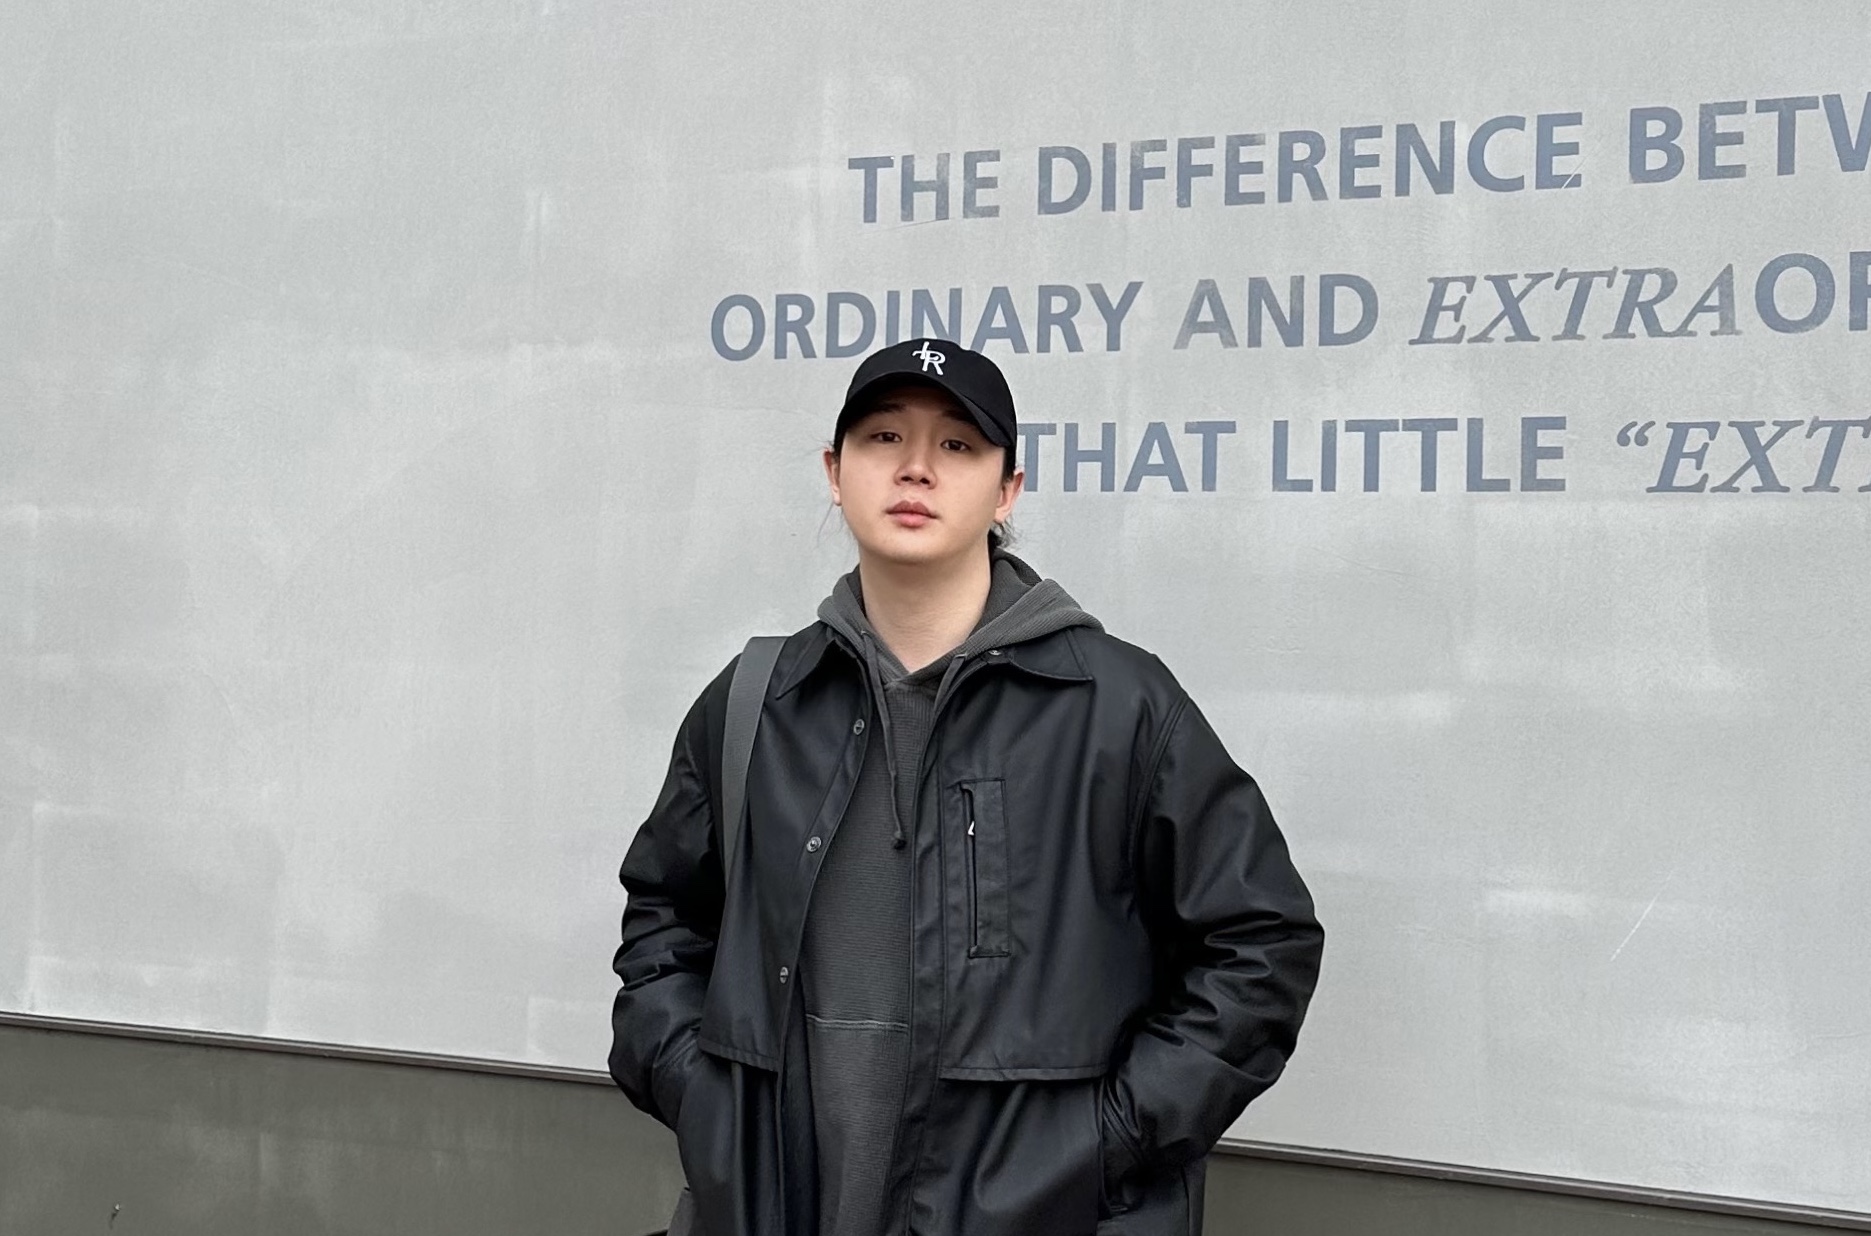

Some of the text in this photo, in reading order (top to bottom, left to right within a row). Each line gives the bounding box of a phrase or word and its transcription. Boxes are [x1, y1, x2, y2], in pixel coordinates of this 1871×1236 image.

[848, 149, 1001, 224] THE
[1037, 111, 1583, 216] DIFFERENCE
[710, 280, 1144, 362] ORDINARY
[1172, 273, 1379, 351] AND
[1016, 415, 1871, 494] THAT LITTLE “EXT
